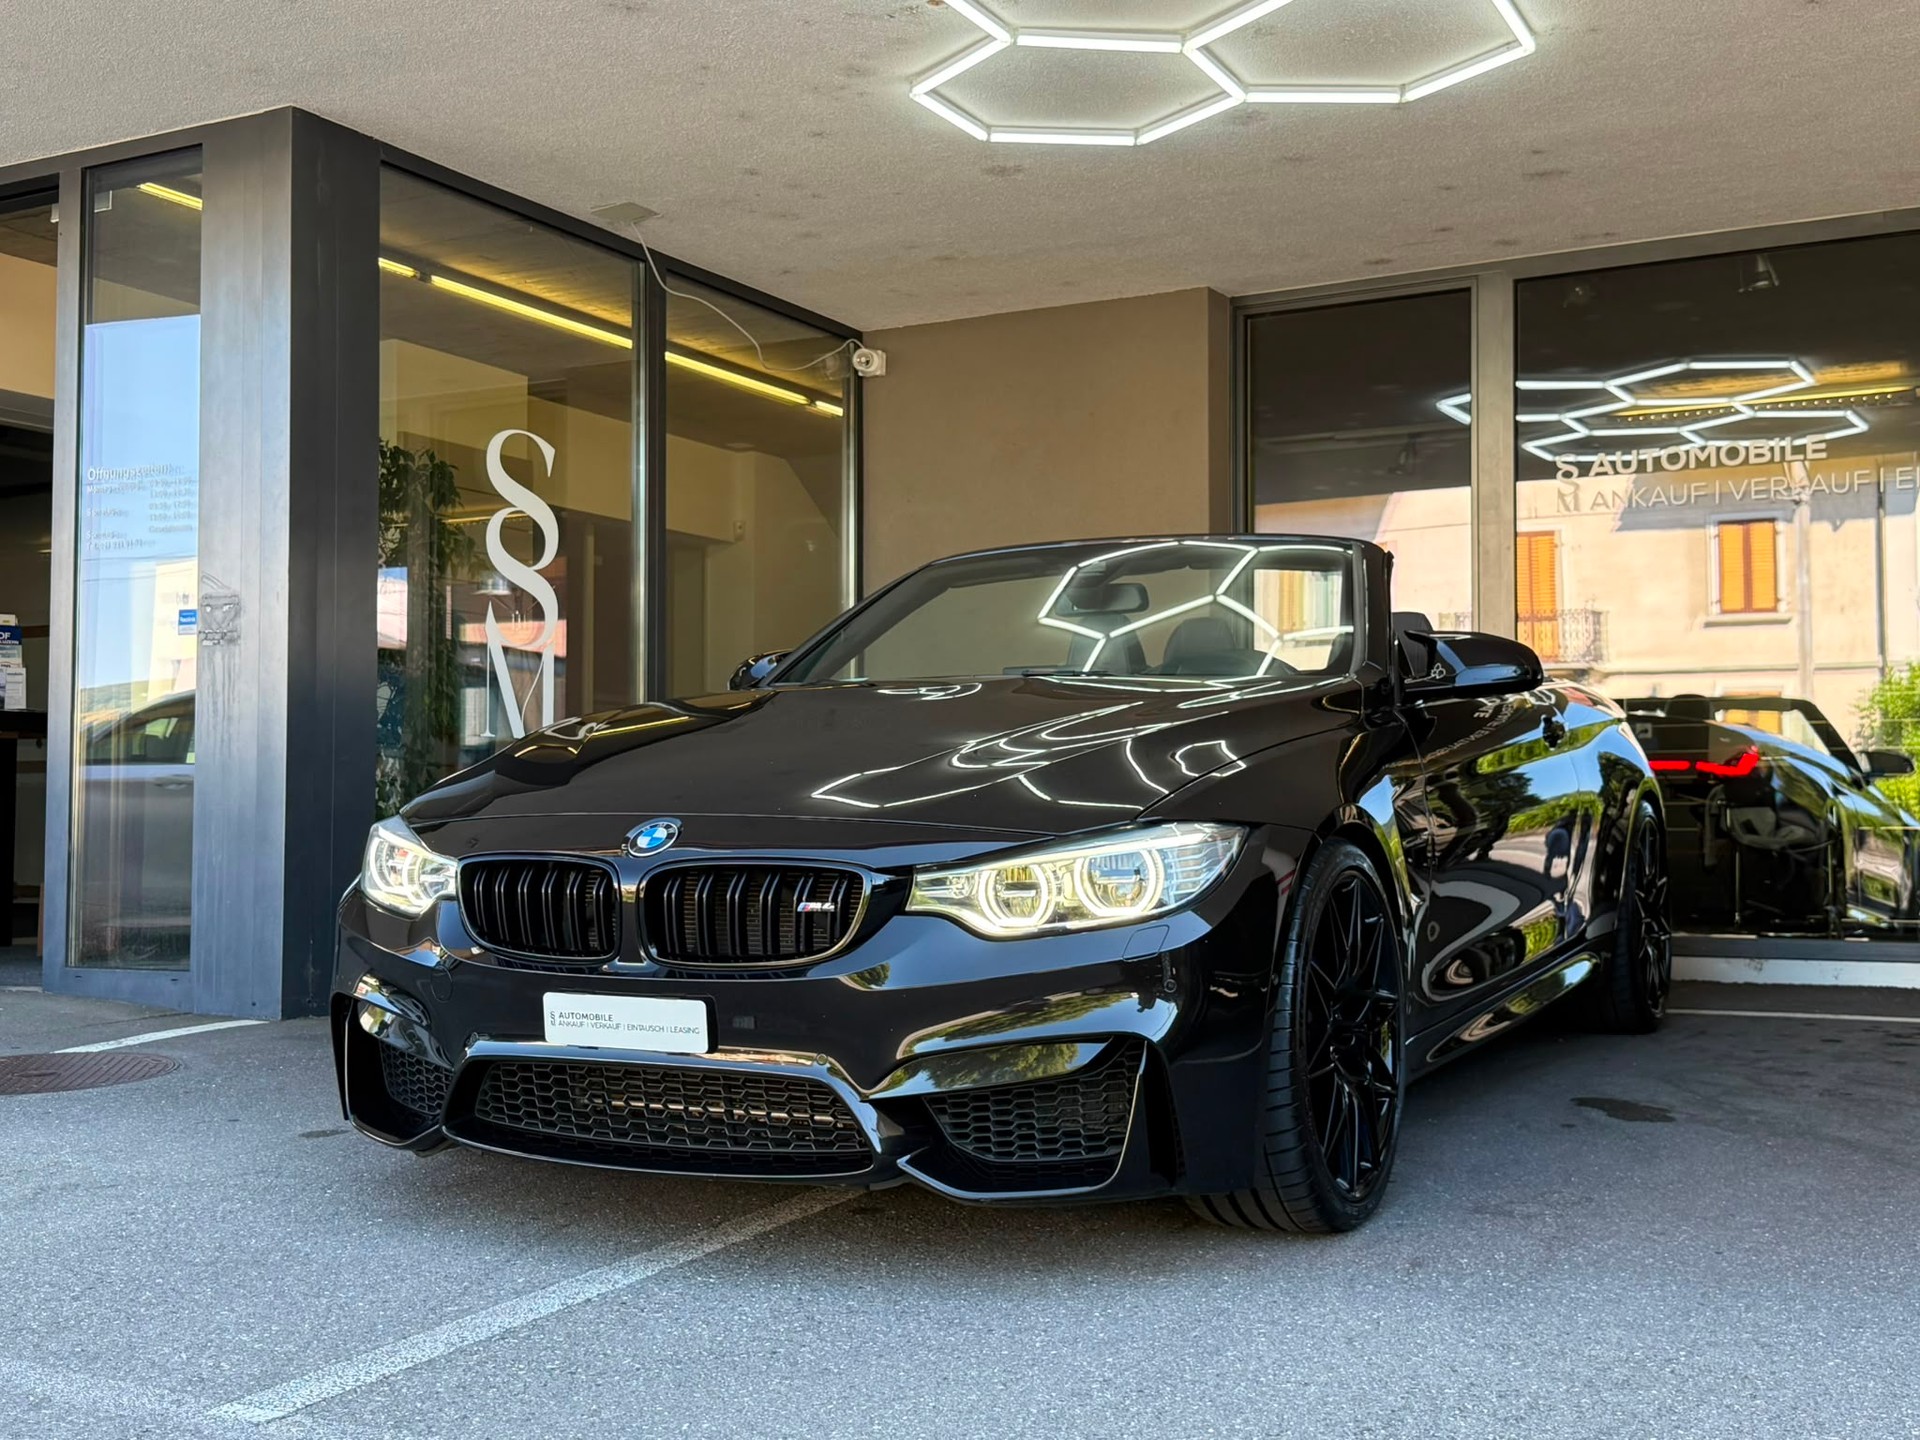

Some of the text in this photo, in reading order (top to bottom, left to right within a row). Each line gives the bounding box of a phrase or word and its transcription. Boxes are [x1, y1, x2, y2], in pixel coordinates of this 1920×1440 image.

[1588, 434, 1828, 477] AUTOMOBILE
[1590, 482, 1708, 511] ANKAUF
[558, 1012, 613, 1021] AUTOMOBILE
[558, 1020, 585, 1028] ANKAUF
[590, 1022, 621, 1030] VERKAUF
[627, 1024, 664, 1032] EINTAUSCH
[670, 1026, 699, 1034] LEASING
